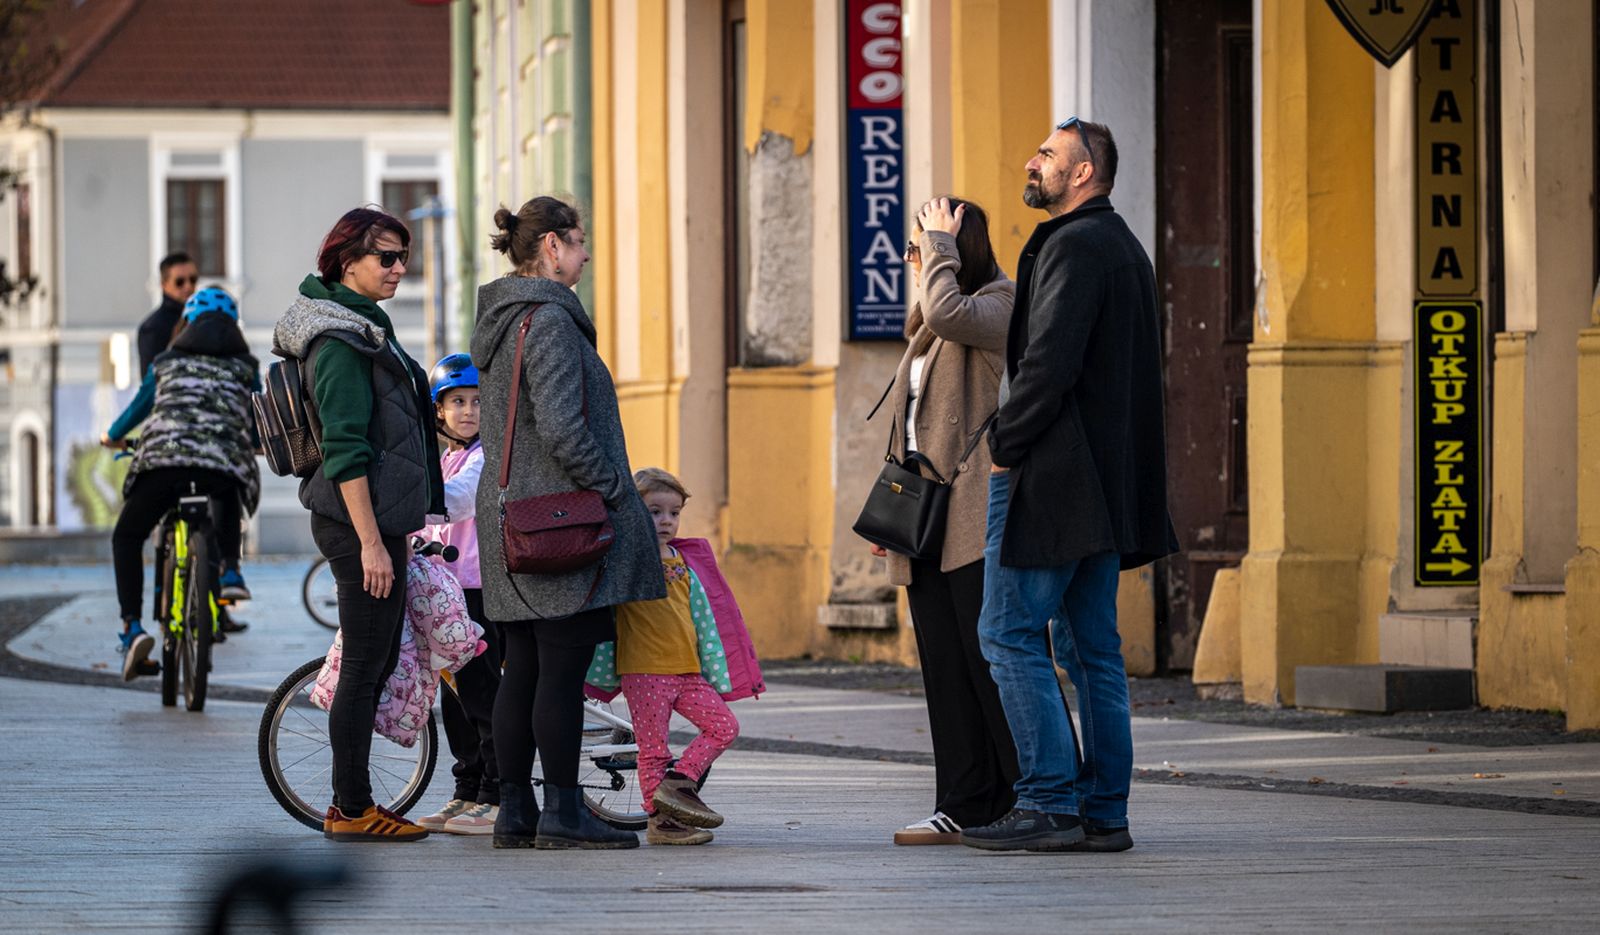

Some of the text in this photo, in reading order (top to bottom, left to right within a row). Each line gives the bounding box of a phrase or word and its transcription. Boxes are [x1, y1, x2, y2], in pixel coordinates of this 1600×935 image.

[860, 115, 902, 302] REFAN
[1429, 310, 1468, 553] OTKUP ZLATA
